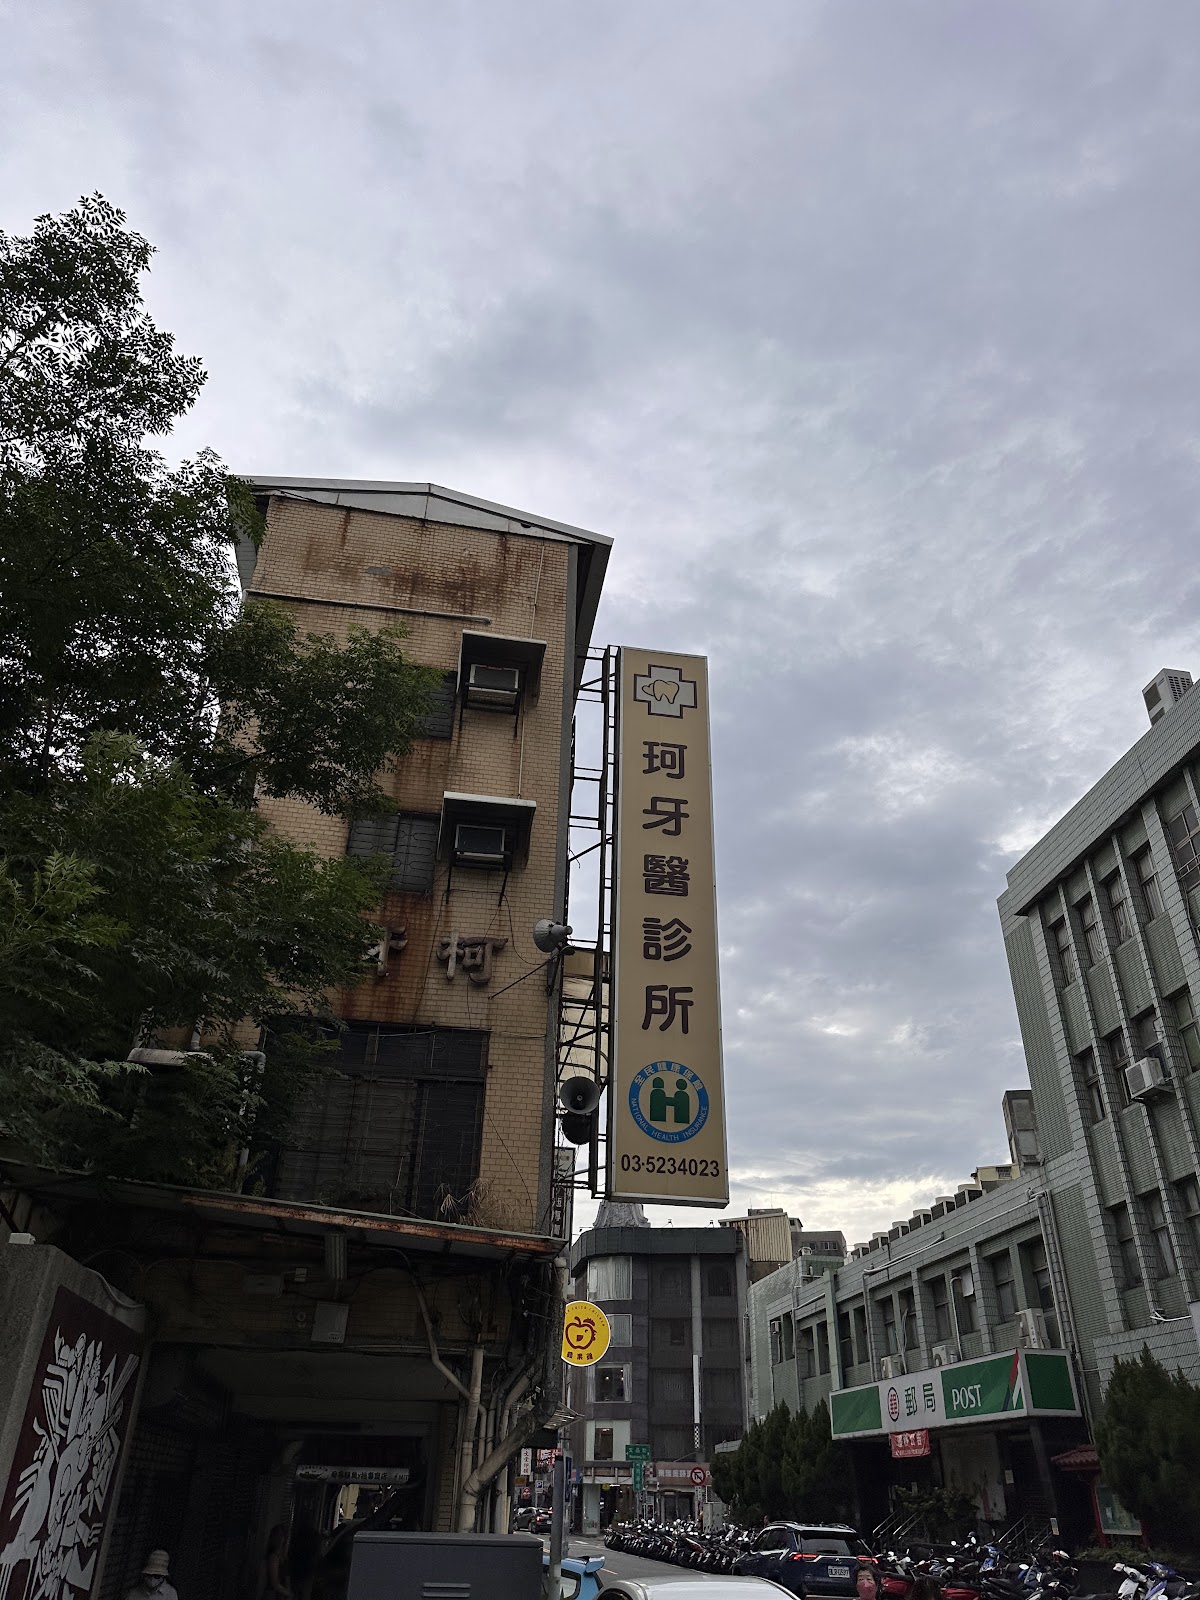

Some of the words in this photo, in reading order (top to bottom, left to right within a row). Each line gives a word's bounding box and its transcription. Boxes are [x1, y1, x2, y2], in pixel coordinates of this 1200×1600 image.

[641, 740, 695, 1035] 珂牙醫診所
[631, 1097, 648, 1132] NATIONAL
[651, 1129, 680, 1142] HEALTH
[682, 1105, 708, 1139] INSURANCE
[904, 1382, 937, 1417] 郵局
[951, 1384, 983, 1411] POST
